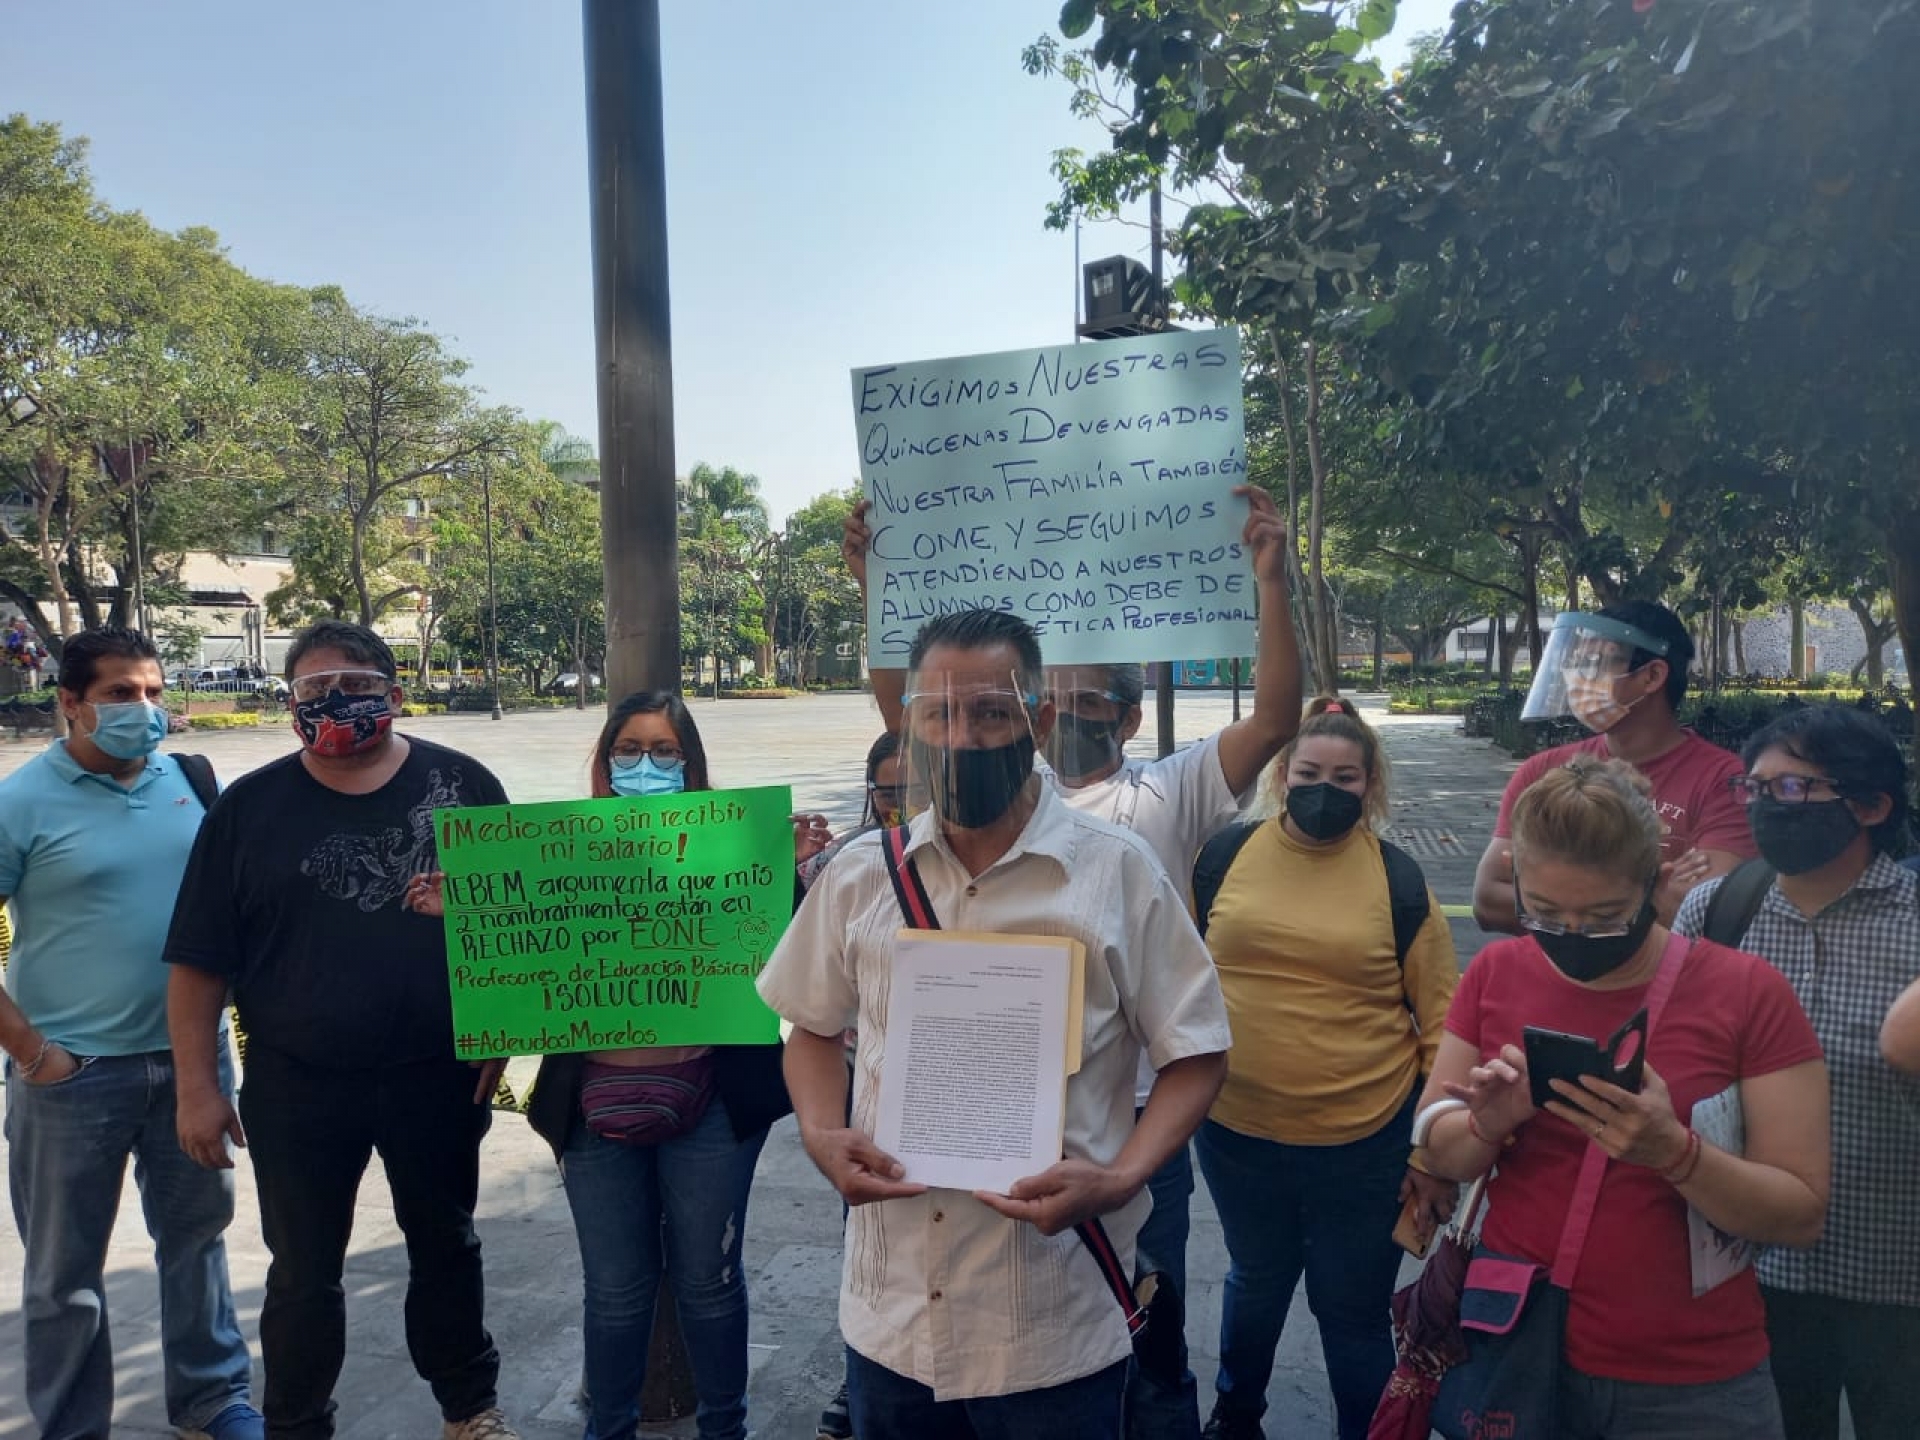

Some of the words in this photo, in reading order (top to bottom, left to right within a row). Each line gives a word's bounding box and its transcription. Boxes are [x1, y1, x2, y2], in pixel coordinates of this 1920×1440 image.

[1027, 344, 1226, 396] NUESTRAS
[873, 477, 994, 518] NUESTRA
[872, 524, 997, 560] COME,
[1005, 517, 1025, 549] Y
[1076, 560, 1091, 579] A
[1100, 543, 1242, 577] NUESTROS
[881, 594, 1014, 625] ALUMNOS
[1025, 588, 1096, 613] COMO
[1104, 579, 1183, 605] DEBE
[1196, 574, 1245, 594] DE
[547, 813, 604, 837] año
[613, 807, 651, 833] sin
[660, 800, 747, 827] recibir
[540, 838, 575, 864] mi
[537, 866, 669, 904] argumenta
[677, 873, 716, 899] que
[724, 863, 773, 889] mis
[456, 914, 475, 934] 2
[480, 894, 648, 930] nombramientos
[721, 894, 752, 914] en
[461, 926, 571, 962] RECHAZO
[581, 929, 623, 958] por
[455, 964, 559, 989] Profesores
[568, 962, 595, 983] de
[457, 1019, 658, 1056] #AdeudosMorelos
